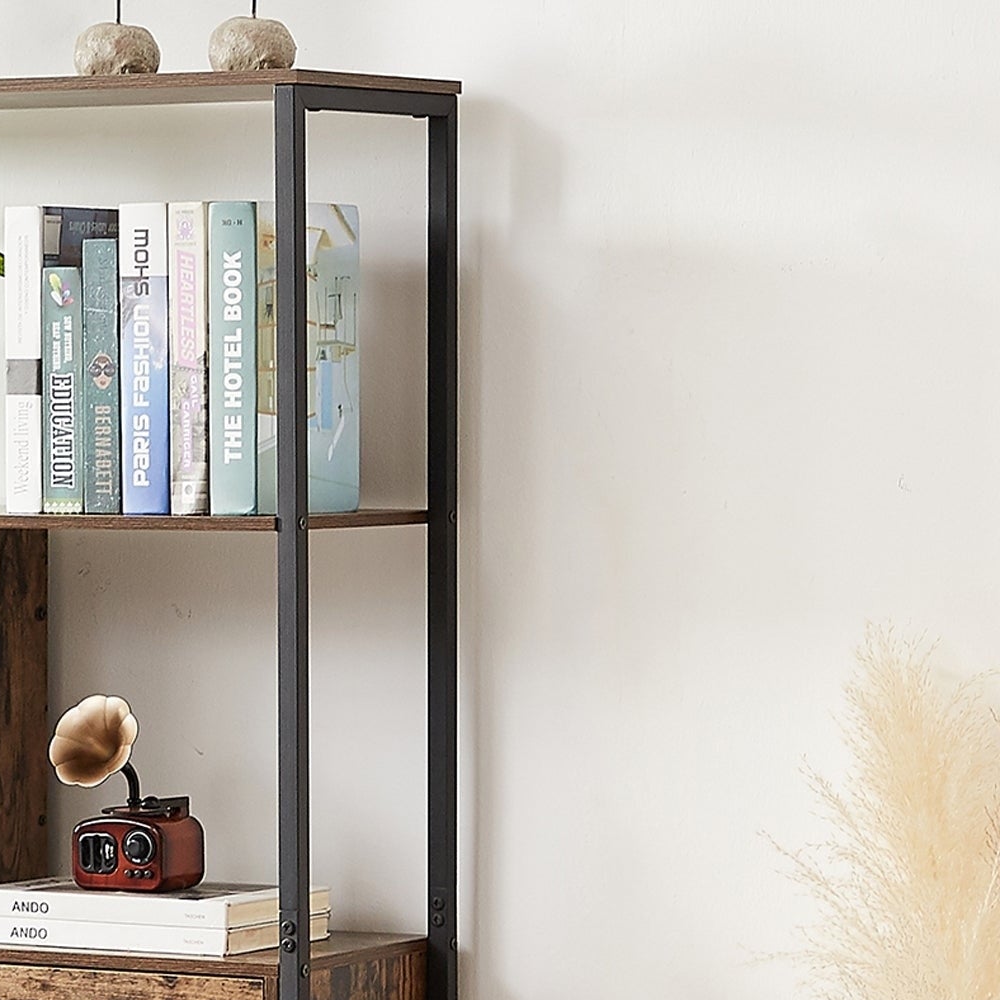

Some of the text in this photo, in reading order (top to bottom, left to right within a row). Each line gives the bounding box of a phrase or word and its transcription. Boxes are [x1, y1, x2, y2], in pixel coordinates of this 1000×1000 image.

[178, 254, 196, 362] HEARTLESS
[223, 251, 243, 464] THE HOTEL BOOK
[13, 401, 33, 495] Weekend living
[51, 374, 74, 488] EDUCATION
[10, 926, 48, 940] ANDO
[12, 901, 49, 914] ANDO
